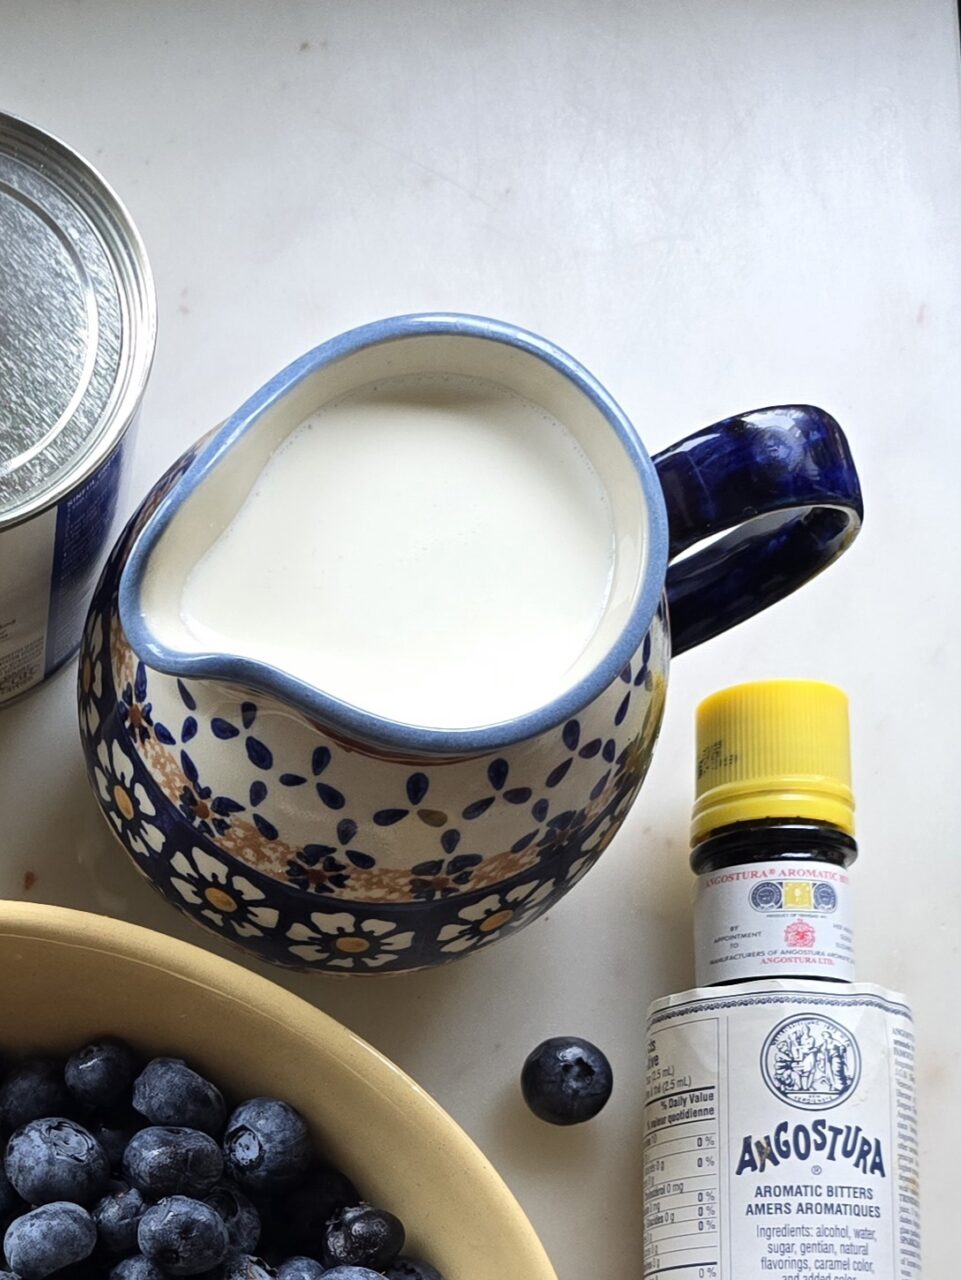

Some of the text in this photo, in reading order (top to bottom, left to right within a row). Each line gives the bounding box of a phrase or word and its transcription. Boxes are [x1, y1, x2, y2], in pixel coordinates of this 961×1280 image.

[778, 868, 838, 881] AROMATIC
[713, 931, 762, 944] APPOINTMENT
[760, 956, 817, 965] ANGOSTURA
[780, 949, 826, 957] ANGOSTURA
[668, 1092, 715, 1108] Daily Value
[668, 1107, 714, 1124] quotidienne
[735, 1118, 886, 1178] ANGOSTURA
[754, 1184, 873, 1200] AROMATIC BITTERS
[745, 1202, 881, 1218] AMERS AROMATIQUES
[756, 1224, 877, 1242] Ingredients: alcohol, water,
[768, 1241, 869, 1256] sugar, gentian, natural
[761, 1256, 811, 1272] flavorings,
[814, 1257, 851, 1271] caramel
